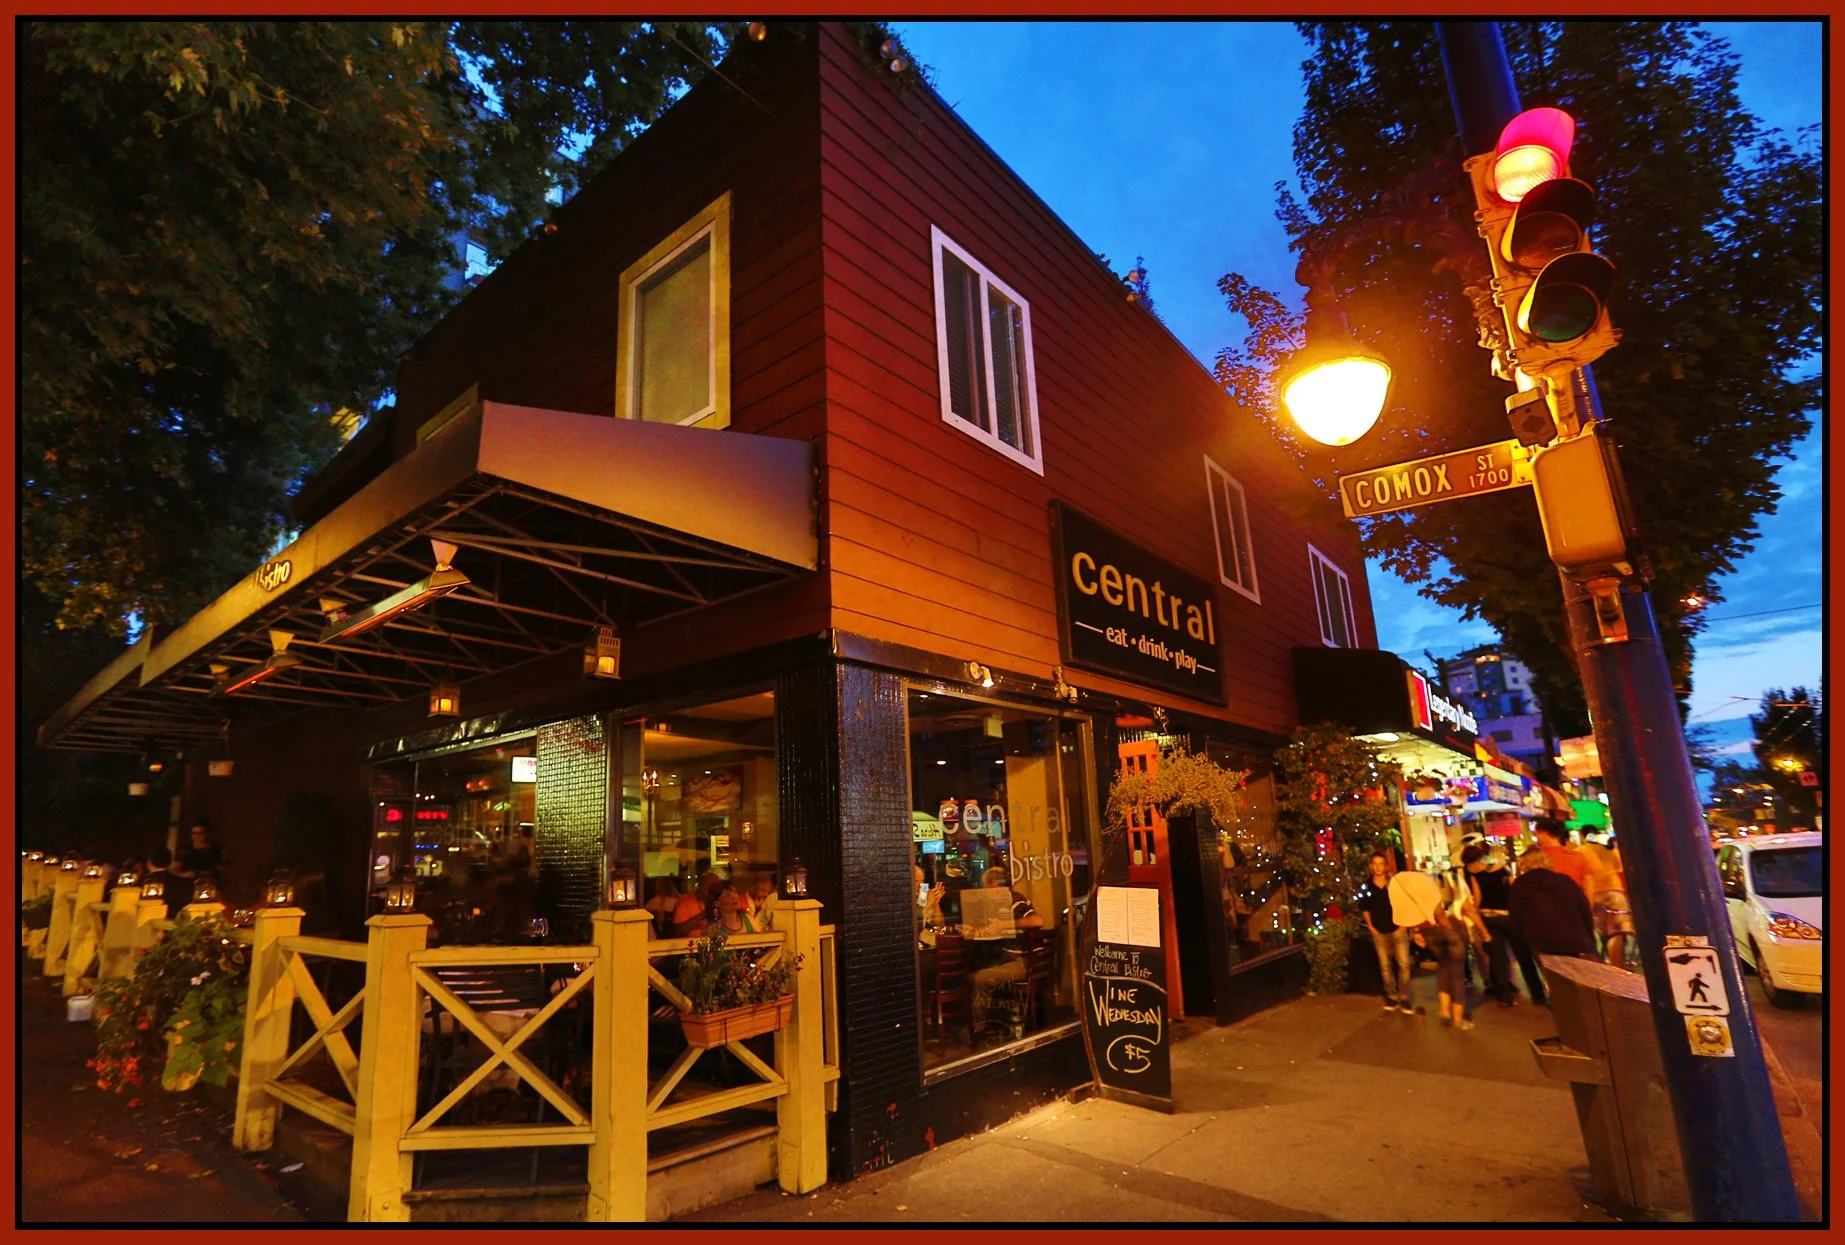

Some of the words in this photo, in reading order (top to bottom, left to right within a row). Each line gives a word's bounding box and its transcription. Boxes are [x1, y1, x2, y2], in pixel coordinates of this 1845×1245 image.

[1356, 464, 1452, 508] COMOX
[1477, 454, 1493, 471] ST
[1469, 468, 1509, 489] 1700
[1072, 552, 1215, 645] central
[1106, 627, 1128, 647] eat
[1138, 634, 1169, 661] drink
[1175, 649, 1197, 674] play
[939, 798, 1072, 835] central
[1010, 841, 1074, 885] bistro
[1090, 955, 1119, 975] Central
[1094, 944, 1128, 960] Welcome
[1125, 1043, 1151, 1073] $5
